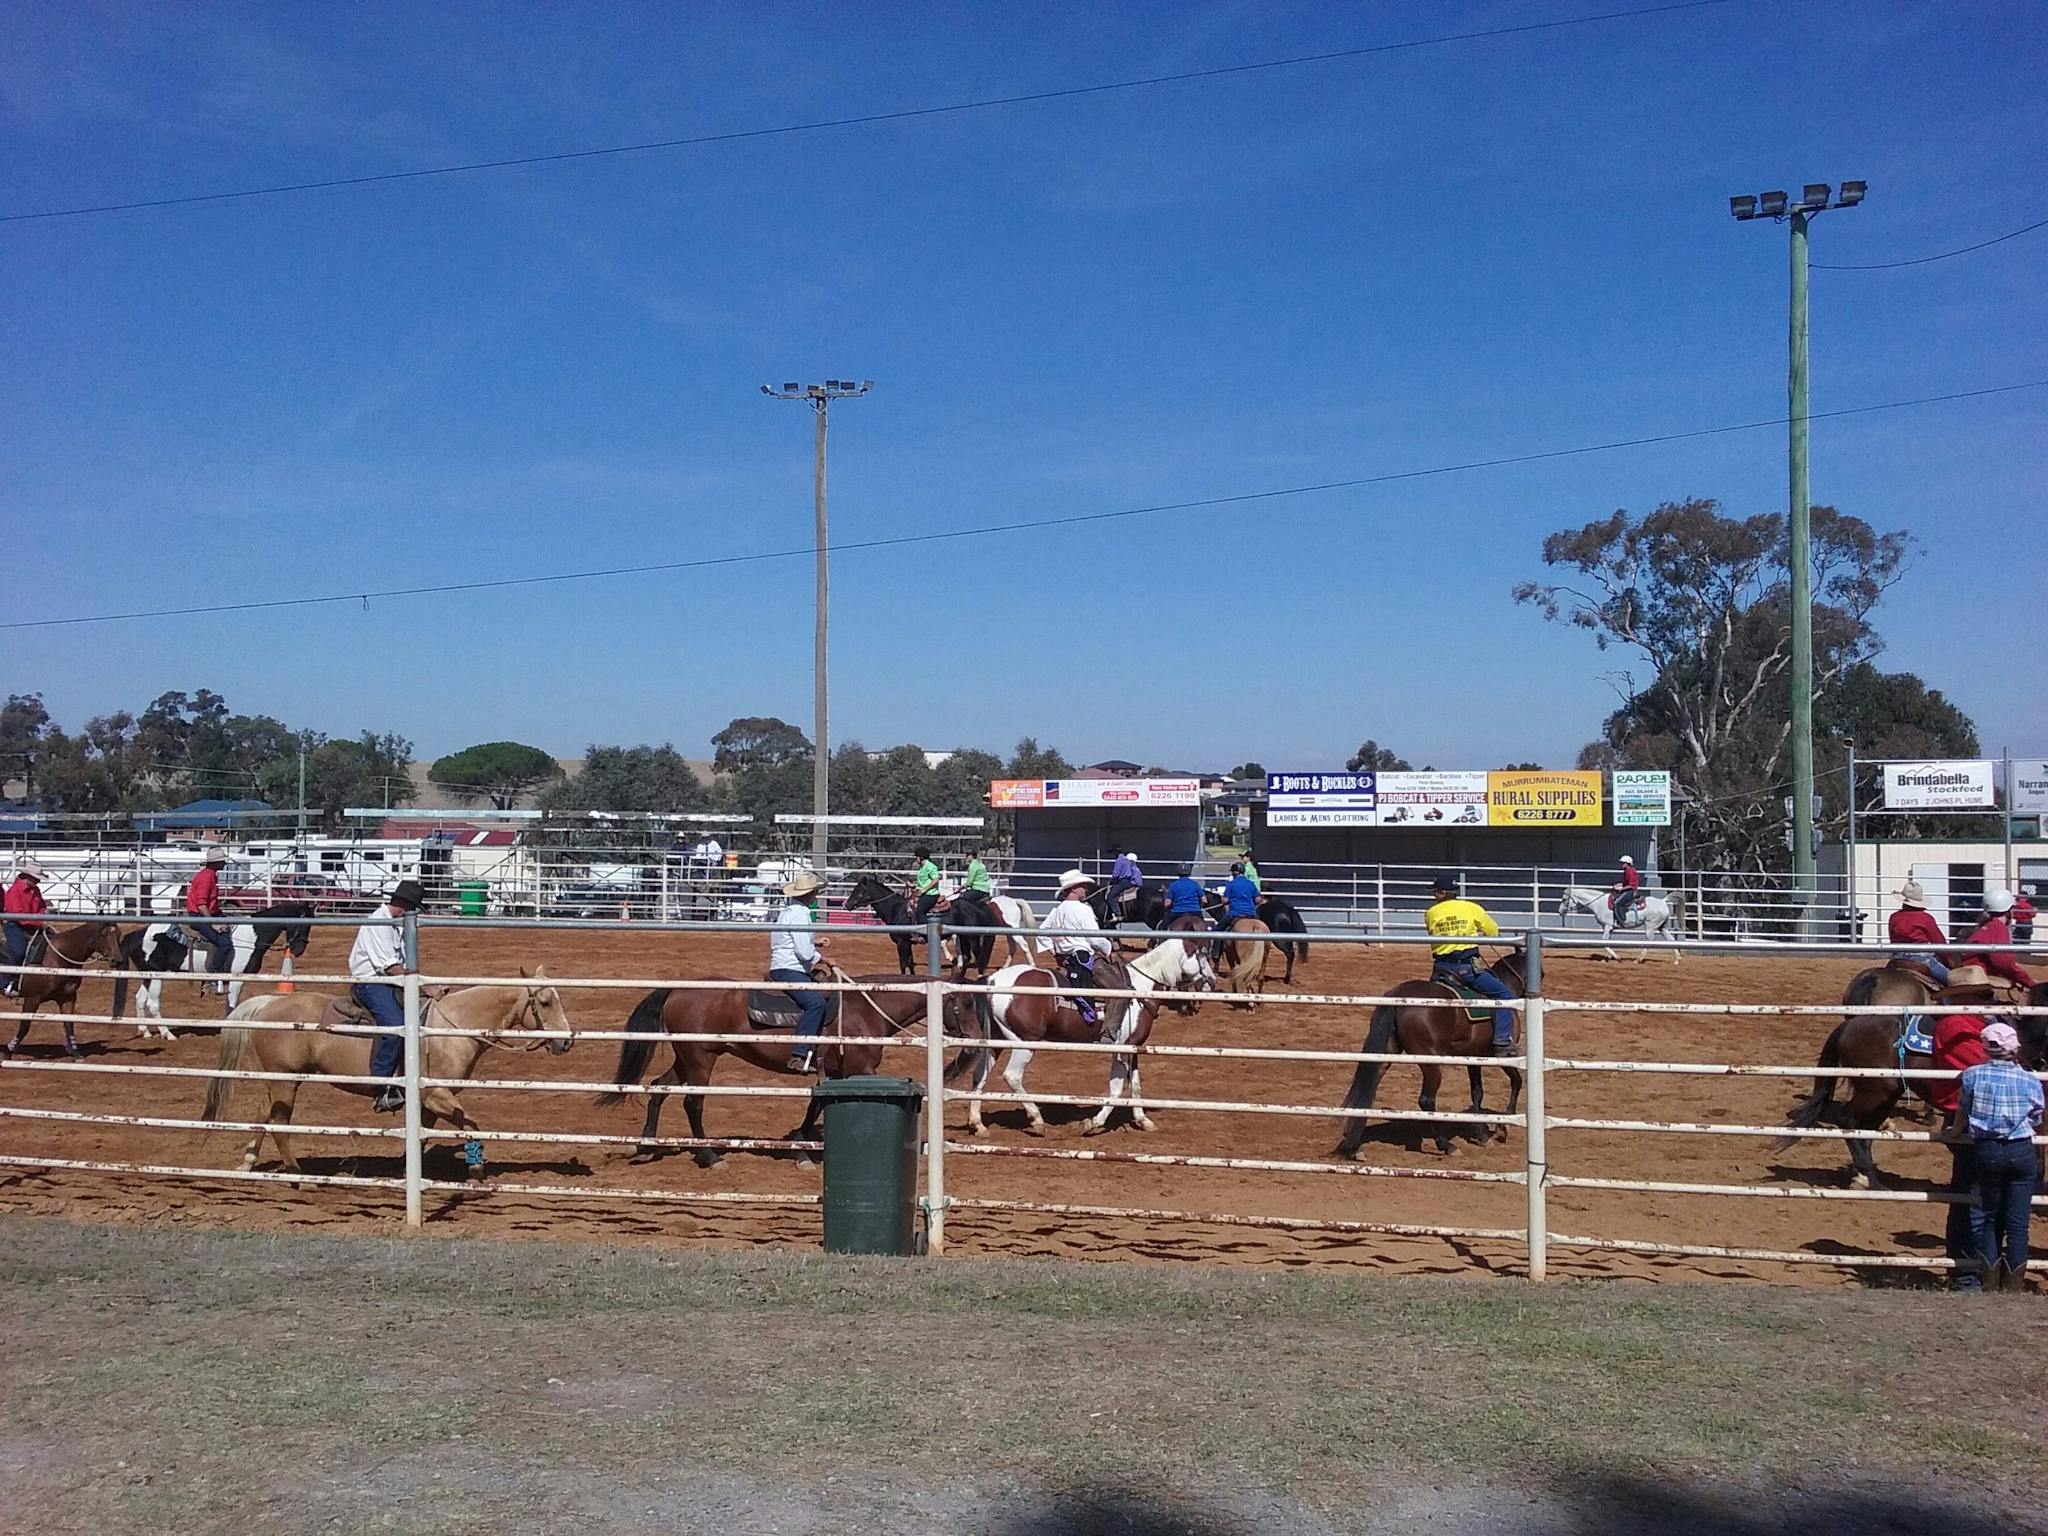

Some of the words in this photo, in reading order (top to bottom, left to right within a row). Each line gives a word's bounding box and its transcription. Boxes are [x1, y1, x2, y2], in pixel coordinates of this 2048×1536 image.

[1282, 775, 1311, 792] BOOTS
[1311, 776, 1320, 790] &
[1321, 775, 1357, 792] BUCKLES
[1502, 776, 1589, 789] MURRUMBATEMAN
[1897, 773, 1970, 786] Brindabella
[1927, 785, 1984, 794] Stockfeed
[1387, 793, 1418, 803] BOBCAT
[1418, 793, 1426, 803] &
[1426, 793, 1453, 803] TIPPER
[1453, 793, 1486, 803] SERVICE
[1493, 790, 1534, 806] RURAL
[1537, 790, 1596, 806] SUPPLIES
[1901, 798, 1919, 806] DAYS
[1930, 797, 1954, 805] JOHNS
[1274, 814, 1298, 823] LADIES
[1300, 814, 1307, 822] &
[1310, 814, 1331, 823] MENS
[1334, 814, 1369, 823] CLOTHING
[1517, 810, 1544, 819] 6226
[1545, 810, 1573, 819] 8777
